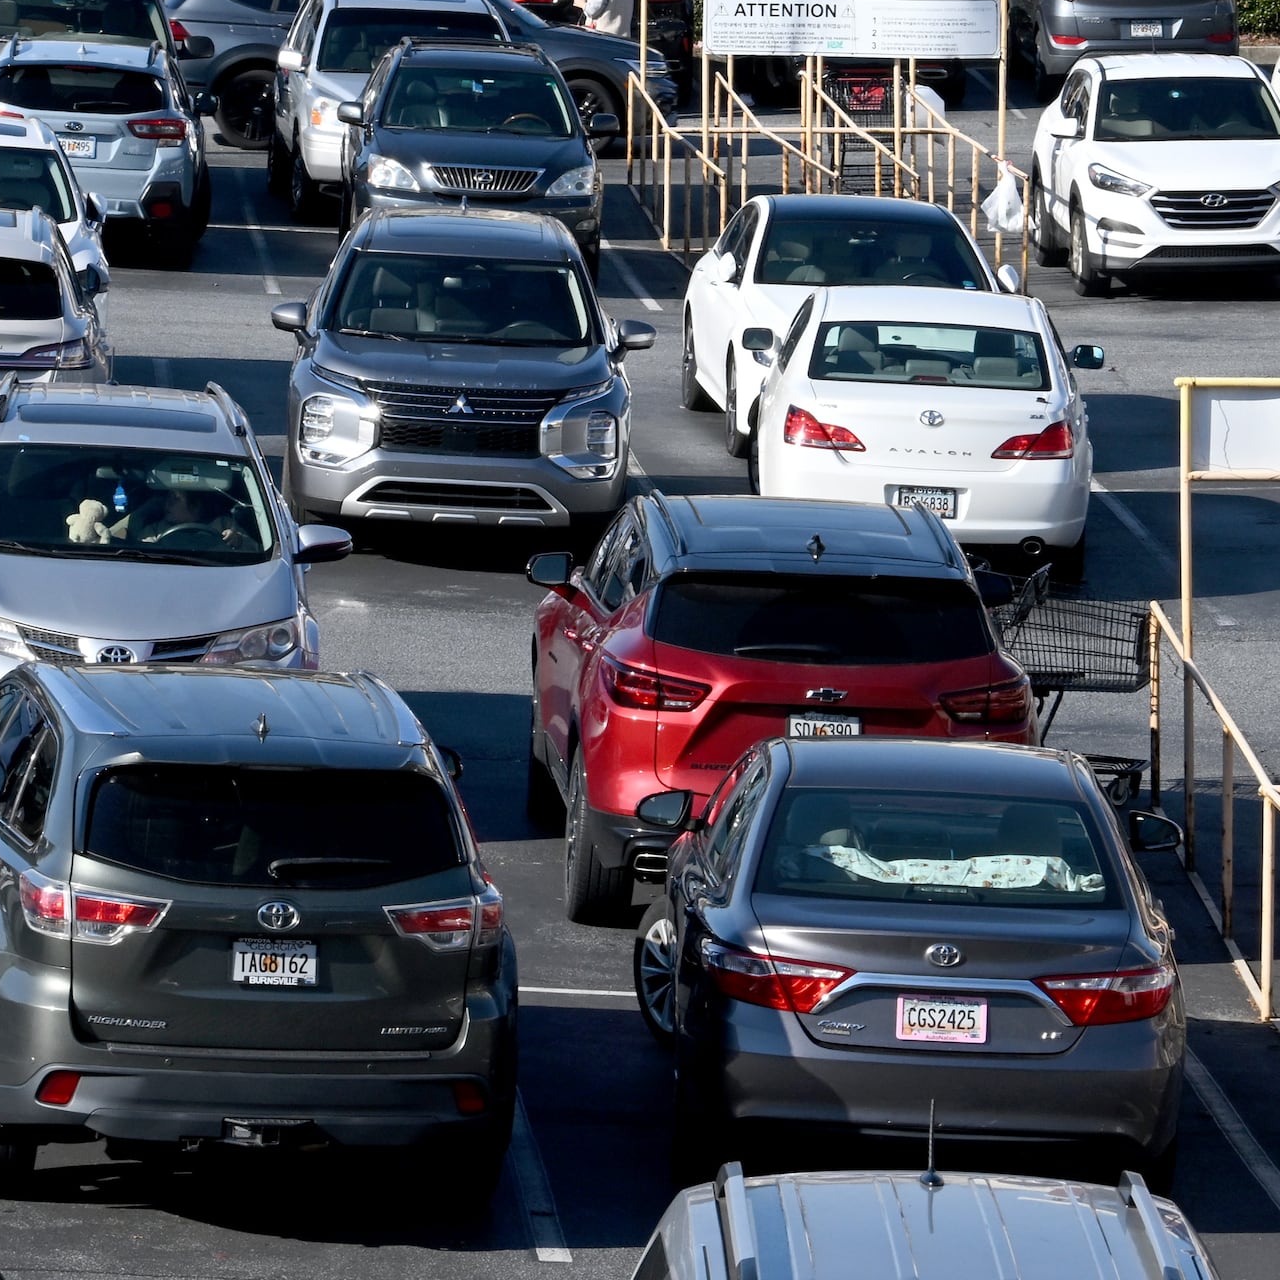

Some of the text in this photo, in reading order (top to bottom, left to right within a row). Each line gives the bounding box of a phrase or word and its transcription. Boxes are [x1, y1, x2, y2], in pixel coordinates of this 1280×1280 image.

[734, 3, 837, 18] ATTENTION
[889, 448, 971, 457] AVALON
[249, 976, 299, 986] BURNSVILLE
[88, 1015, 167, 1029] HIGHLANDER
[907, 1007, 976, 1030] CGS2425
[381, 1026, 422, 1034] LIMITED
[818, 1020, 866, 1031] Camry
